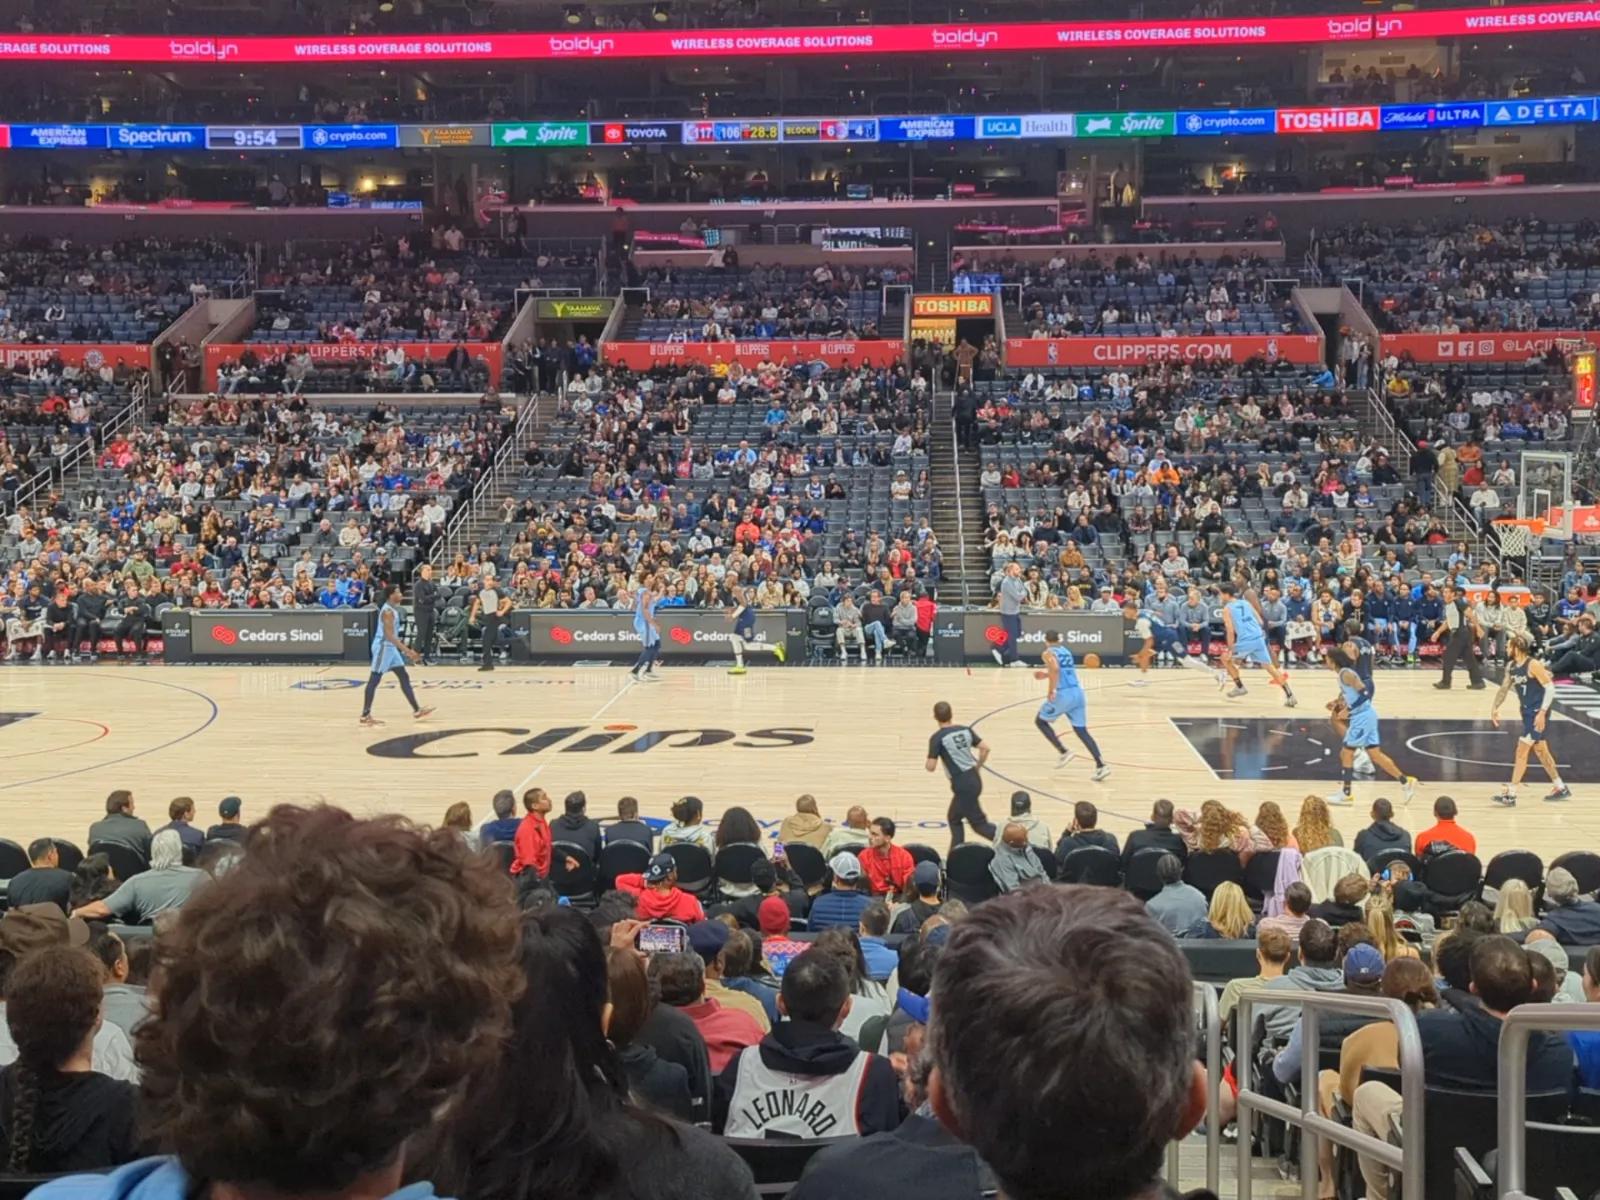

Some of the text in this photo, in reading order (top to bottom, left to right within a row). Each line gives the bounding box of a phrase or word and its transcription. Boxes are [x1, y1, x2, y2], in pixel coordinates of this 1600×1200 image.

[1328, 18, 1402, 36] boldyn
[1465, 15, 1537, 28] WIRELESS
[932, 28, 998, 46] boldyn
[1057, 25, 1266, 42] WIRELESS COVERAGE SOLUTIONS
[40, 43, 111, 55] SOLUTIONS
[295, 42, 492, 56] WIRELESS COVERAGE SOLUTIONS
[549, 37, 614, 54] boldyn
[672, 35, 873, 50] WIRELESS COVERAGE SOLUTIONS
[169, 41, 238, 59] boldyn
[1436, 108, 1480, 121] ULTRA
[1518, 104, 1587, 119] DELTA
[899, 119, 955, 129] AMERICAN
[987, 121, 1017, 133] UCLA
[1025, 119, 1069, 134] Health
[1120, 115, 1166, 132] Sprite
[1202, 115, 1265, 129] crypto.com
[1281, 111, 1374, 129] TOSHIBA
[30, 128, 86, 137] AMERICAN
[119, 128, 192, 146] Spectrum
[329, 130, 387, 144] crypto.com
[535, 125, 578, 142] Sprite
[625, 128, 667, 139] TOYOTA
[721, 126, 740, 139] 106
[751, 125, 777, 138] 28.8
[827, 125, 835, 136] 6
[855, 125, 863, 136] 4
[907, 127, 955, 138] EXPRESS
[38, 136, 87, 145] EXPRESS
[234, 130, 277, 146] 9:54
[917, 299, 988, 313] TOSHIBA
[1093, 343, 1231, 360] CLIPPERS.COM
[1235, 605, 1244, 617] 7
[239, 628, 322, 642] Cedars Sinai
[574, 630, 643, 641] Cedars Sina
[694, 630, 732, 642] Cedar
[1067, 630, 1102, 642] Sinai
[1058, 654, 1074, 667] 22
[1520, 685, 1527, 696] 7
[366, 725, 815, 758] Clips
[742, 1089, 837, 1136] LEONARD
